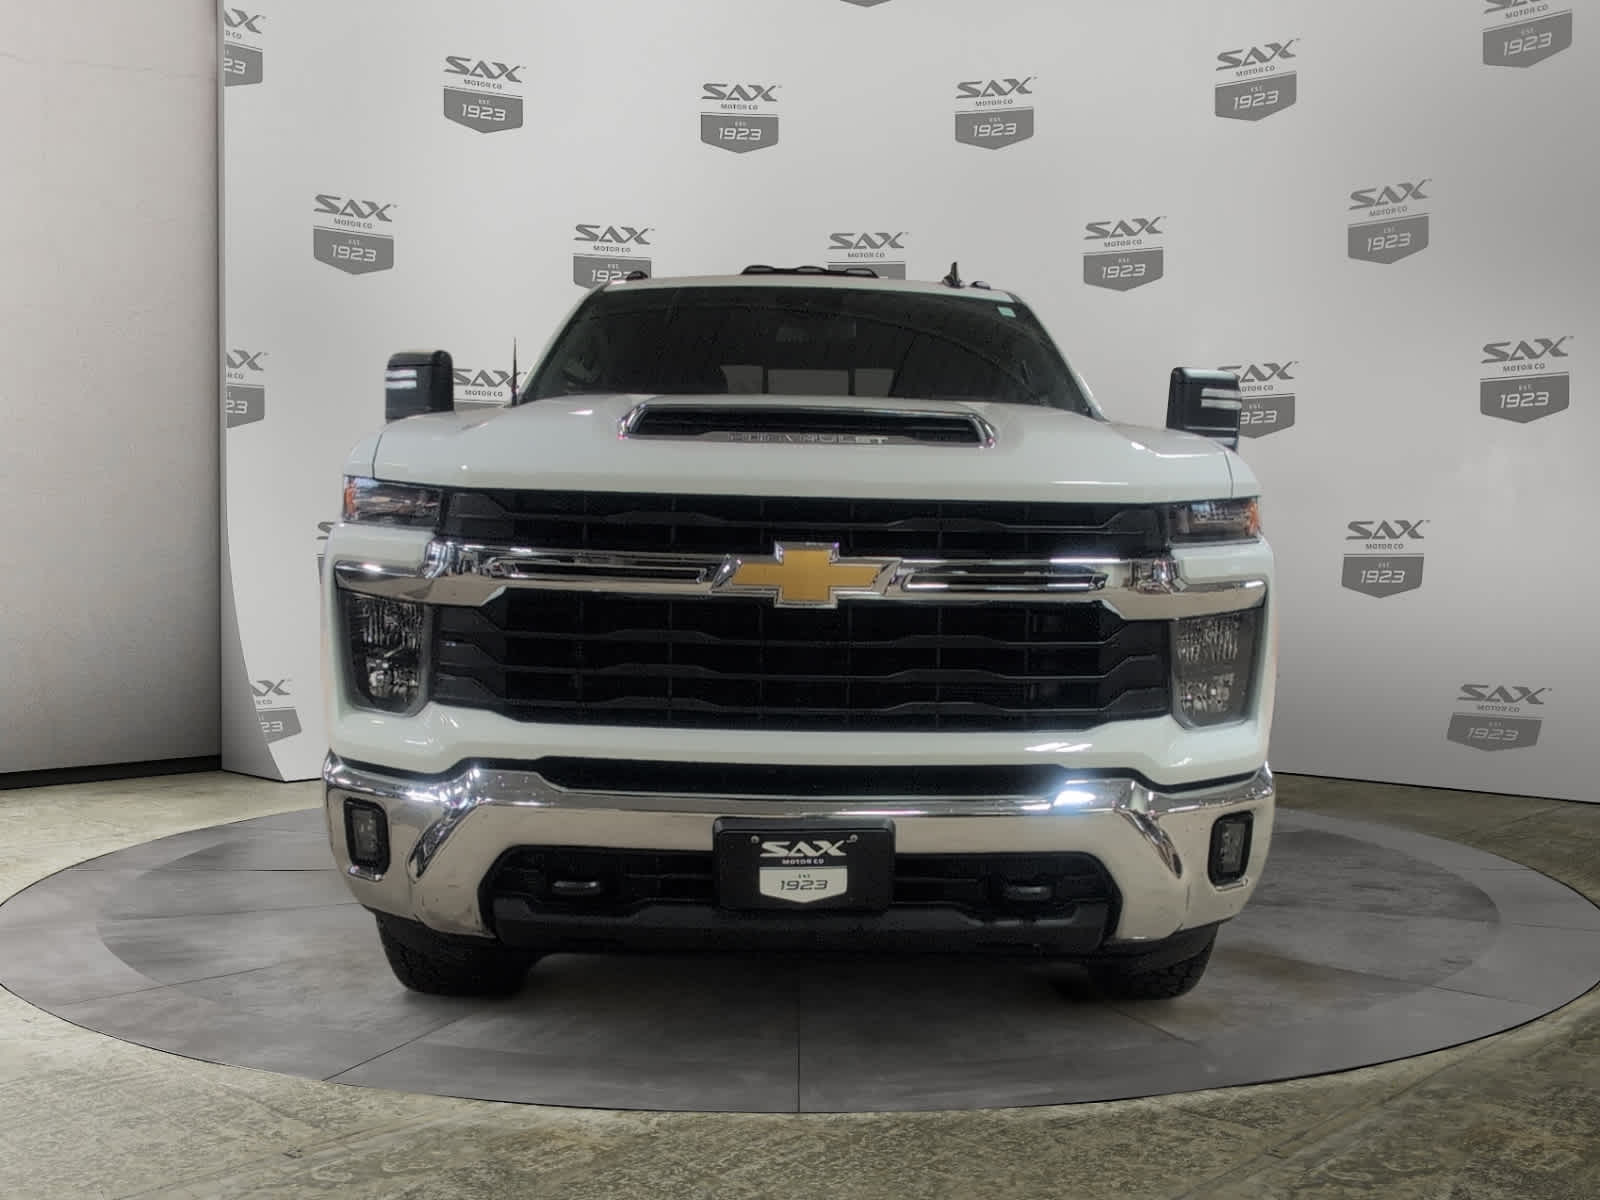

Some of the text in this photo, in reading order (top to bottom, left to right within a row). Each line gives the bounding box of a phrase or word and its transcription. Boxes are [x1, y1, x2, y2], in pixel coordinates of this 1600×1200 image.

[1503, 32, 1552, 56] 1923
[1215, 39, 1296, 71] SAX
[224, 57, 246, 75] 23
[444, 56, 522, 83] SAX
[701, 83, 778, 102] SAX
[955, 76, 1033, 99] SAX
[1234, 90, 1279, 110] 1923
[462, 104, 506, 121] 1923
[719, 128, 762, 141] 1923
[972, 123, 1017, 137] 1923
[1348, 179, 1429, 210] SAX
[313, 194, 393, 222] SAX
[574, 224, 651, 245] SAX
[1083, 216, 1163, 240] SAX
[827, 232, 904, 249] SAX
[1368, 232, 1411, 252] 1923
[331, 244, 377, 262] 1923
[1102, 264, 1146, 279] 1923
[1481, 336, 1568, 364] SAX
[1503, 364, 1532, 372] MOTOR
[226, 400, 248, 414] 23
[1500, 391, 1550, 408] 1923
[1240, 410, 1277, 424] 923
[1345, 520, 1424, 540] SAX
[1361, 570, 1406, 584] 1923
[1457, 684, 1545, 705] SAX
[1467, 727, 1520, 741] 1923
[760, 840, 847, 857] SAX
[780, 880, 828, 891] 1923
